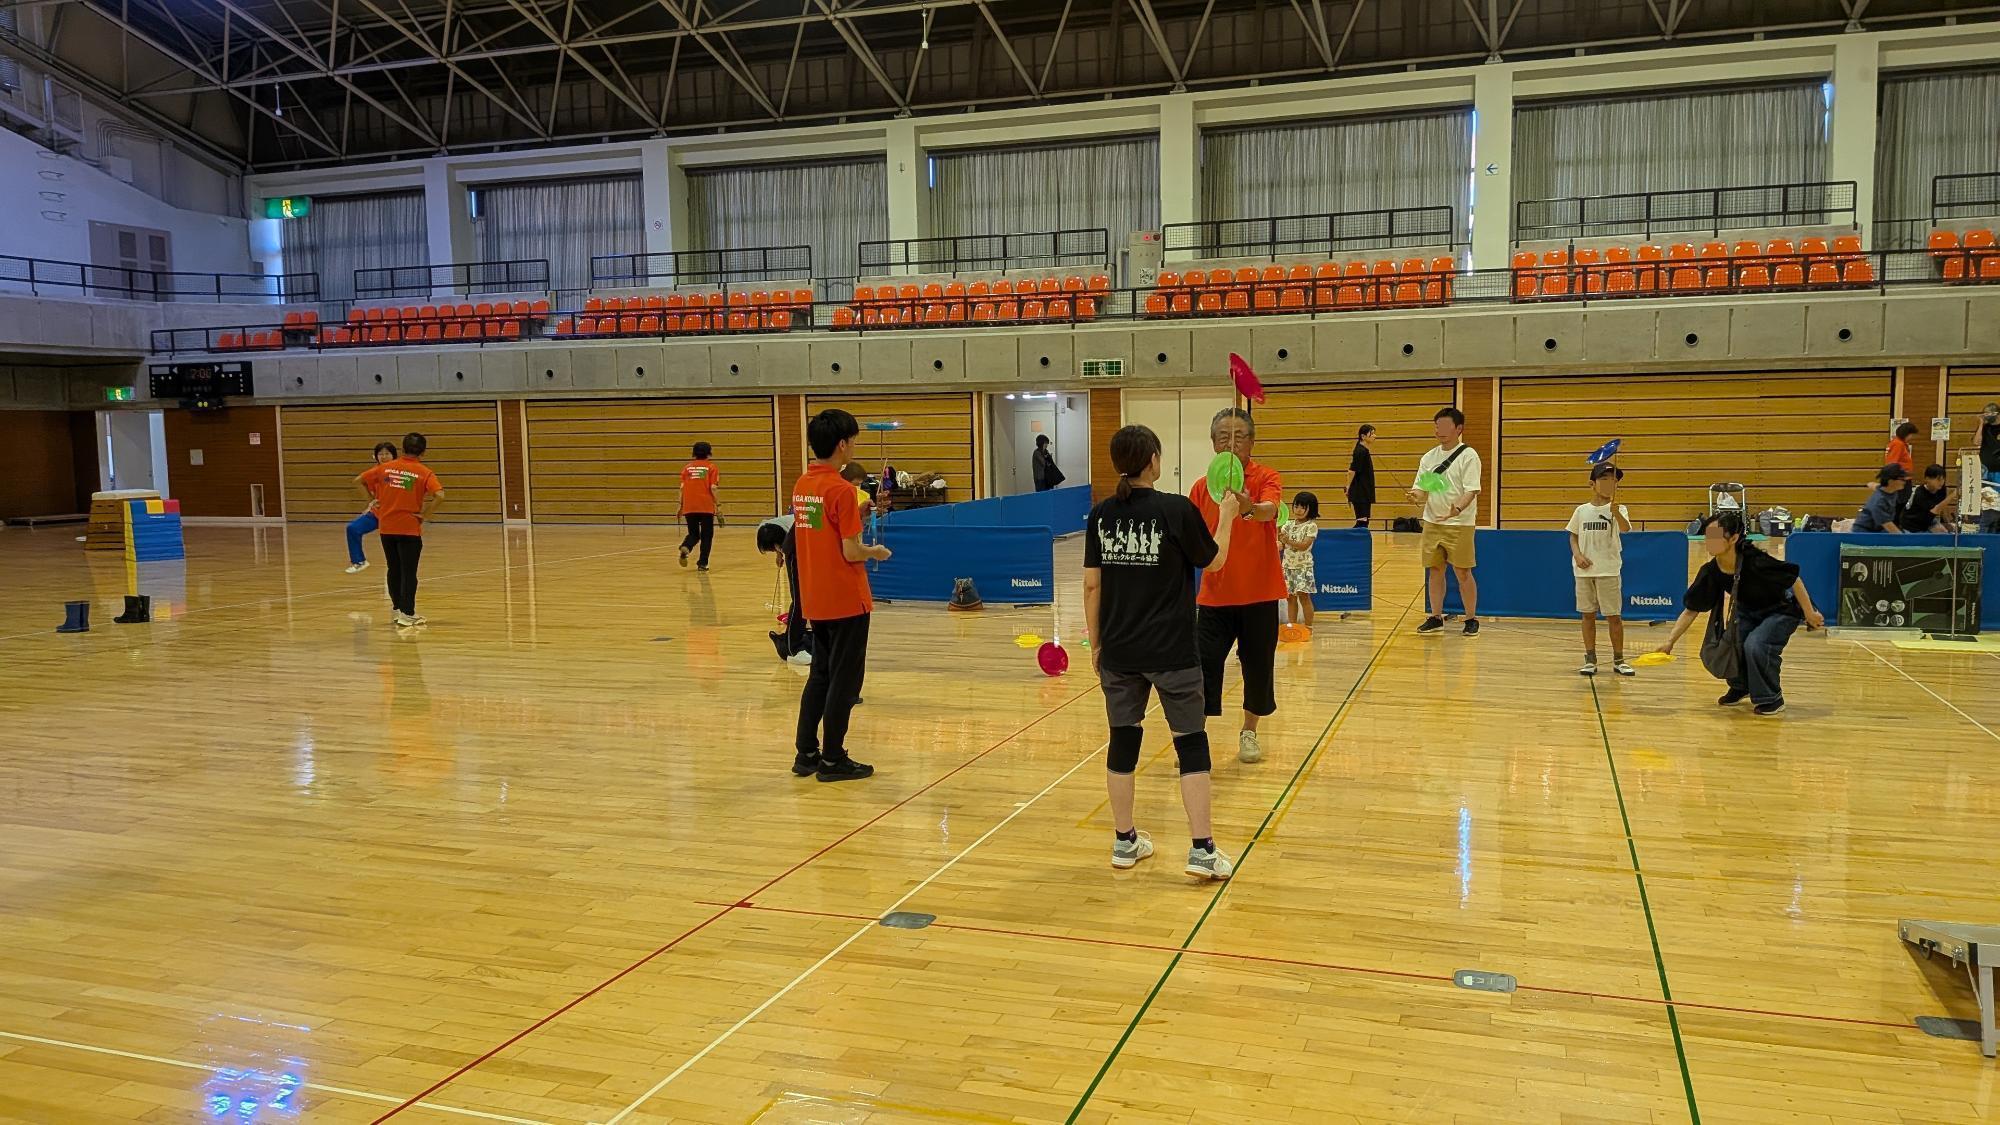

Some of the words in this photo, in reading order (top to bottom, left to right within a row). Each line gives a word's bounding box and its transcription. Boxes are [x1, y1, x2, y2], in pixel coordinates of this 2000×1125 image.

[1583, 521, 1608, 531] PUMA
[1011, 578, 1043, 587] Nittaku
[1321, 584, 1359, 594] Nittaku
[1630, 595, 1673, 606] Nittaku
